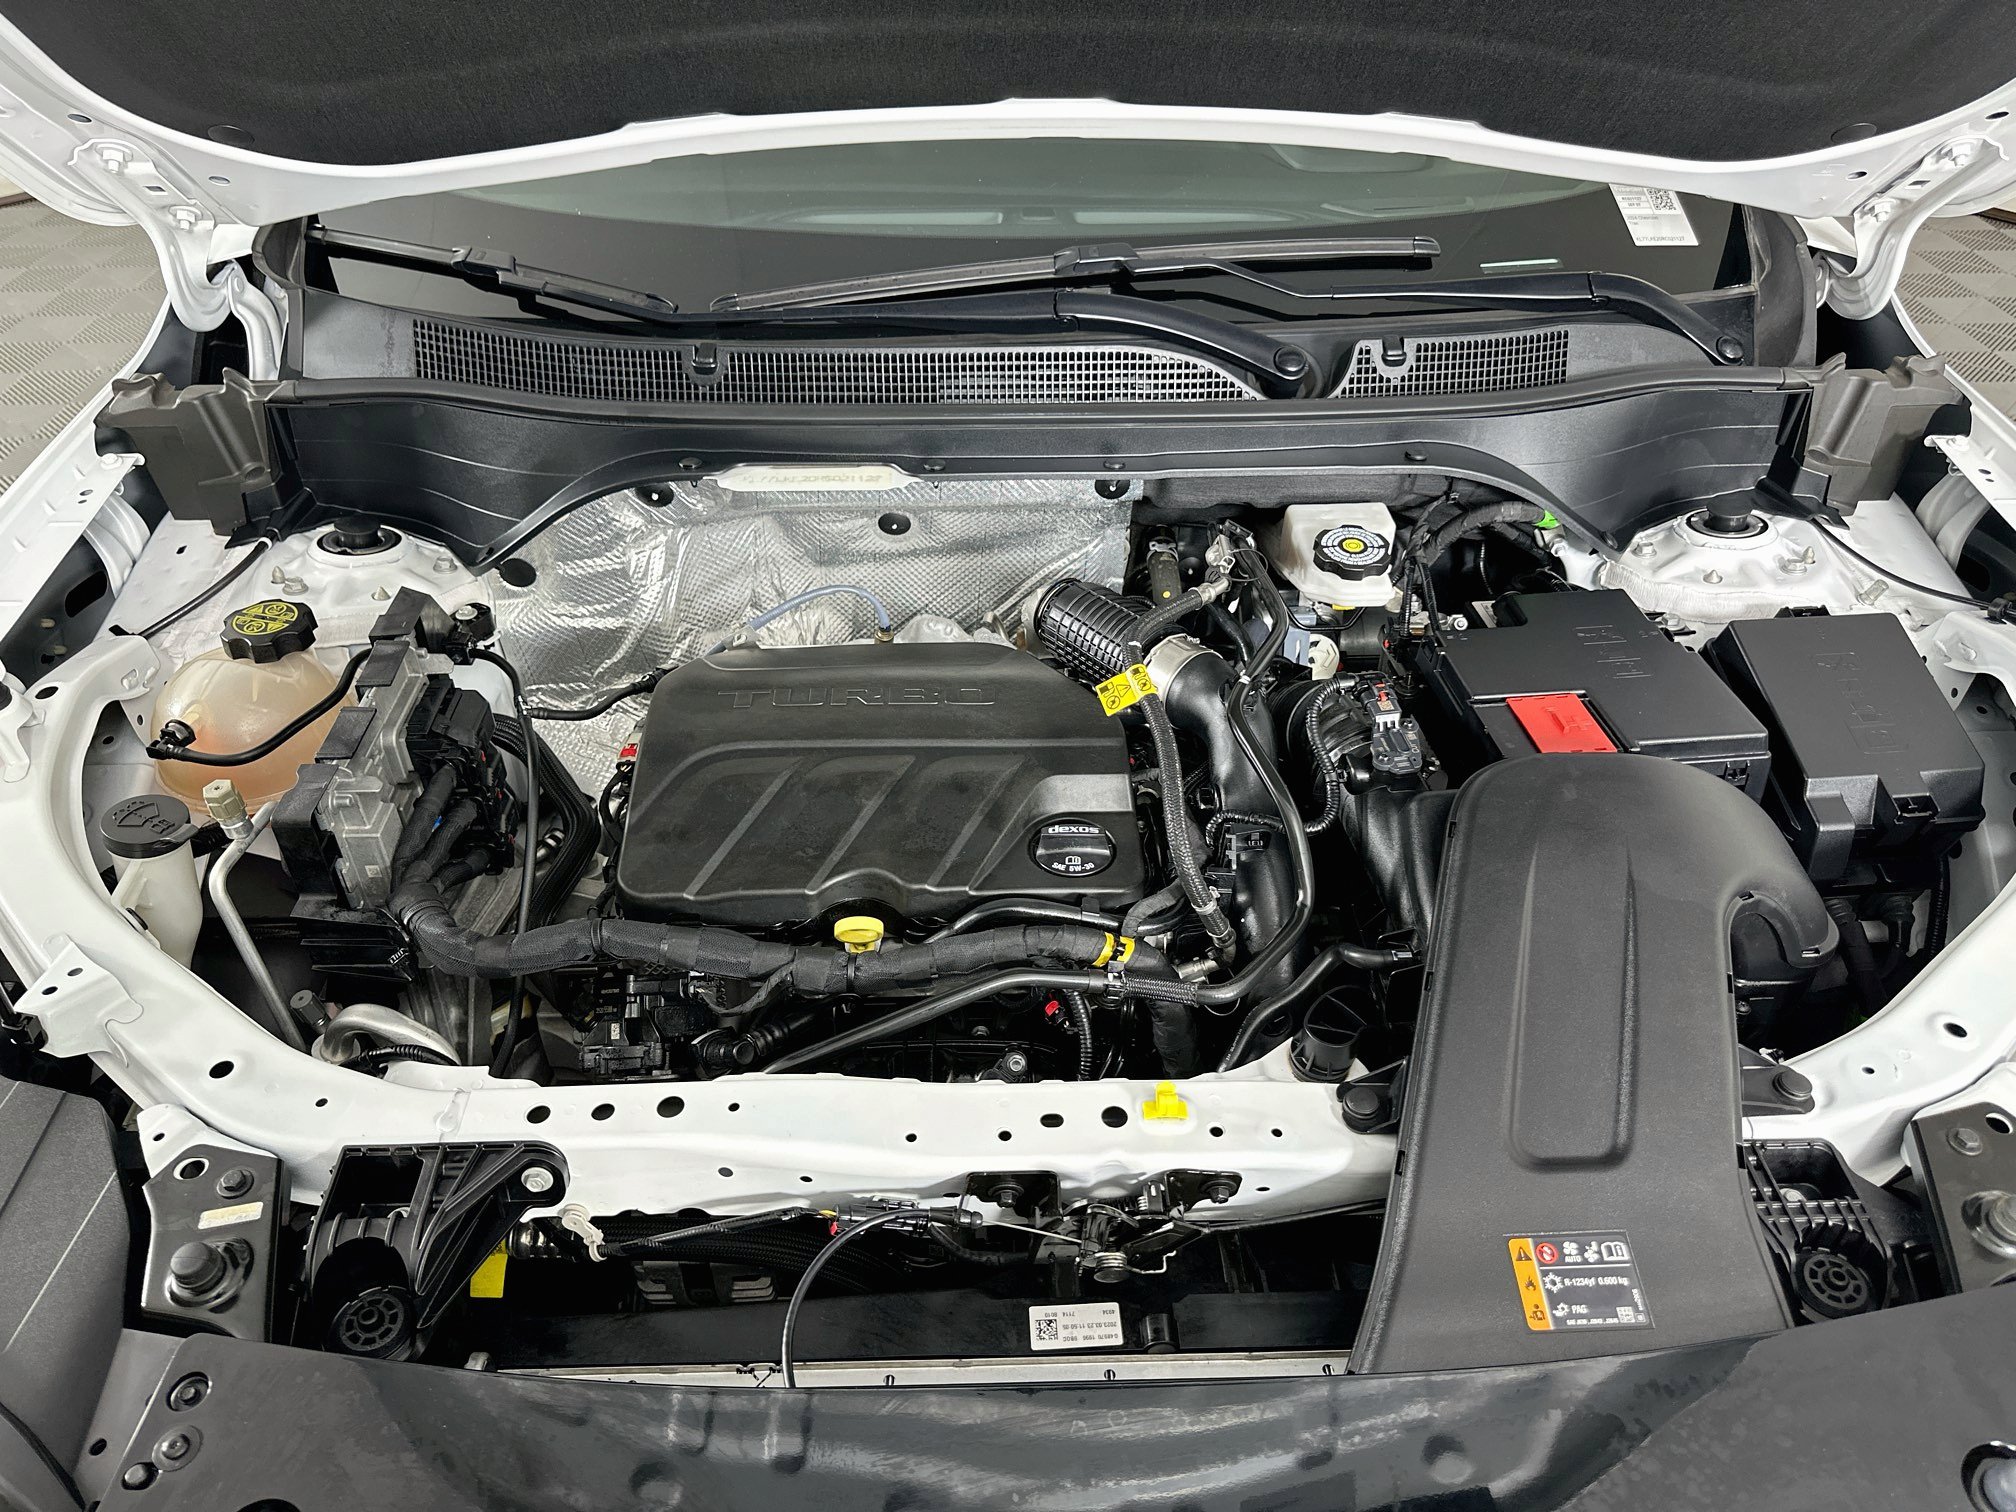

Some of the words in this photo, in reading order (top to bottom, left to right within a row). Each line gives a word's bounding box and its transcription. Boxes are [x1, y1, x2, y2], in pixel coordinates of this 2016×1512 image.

[718, 687, 997, 708] TURBO
[1048, 825, 1100, 834] dexos
[1051, 862, 1067, 871] SAE
[1069, 862, 1095, 872] 5W-30
[1564, 1277, 1596, 1287] R-1234yf
[1571, 1304, 1588, 1314] PAG
